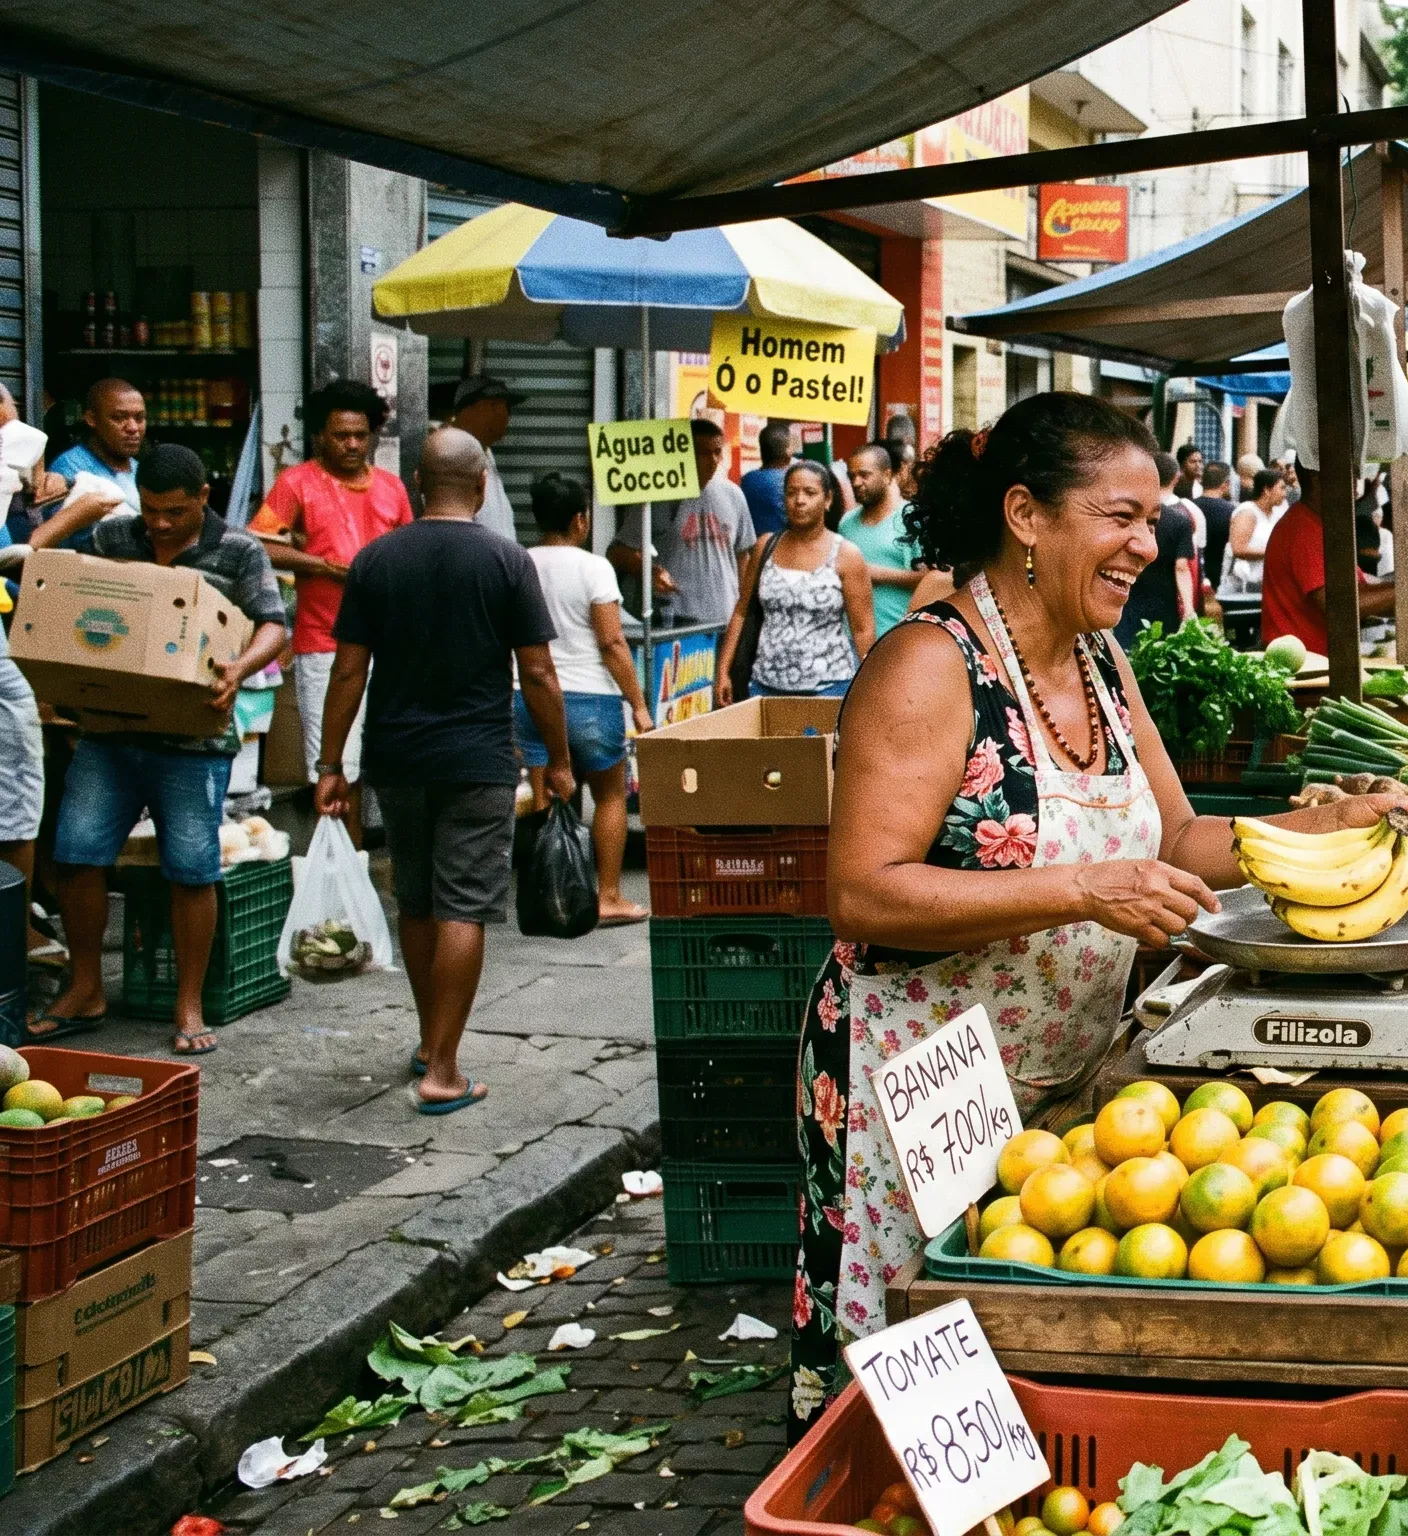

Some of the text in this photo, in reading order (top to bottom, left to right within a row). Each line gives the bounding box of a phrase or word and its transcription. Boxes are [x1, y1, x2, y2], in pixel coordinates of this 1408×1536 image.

[741, 327, 845, 364] Homem
[716, 355, 864, 403] Ó o Pastel!
[596, 425, 689, 465] Água de
[606, 461, 687, 493] Cocco!
[1266, 1021, 1358, 1045] Filizola
[883, 1024, 987, 1122] BANANA
[906, 1083, 1014, 1193] R$ 7,00/kg
[861, 1318, 979, 1401] TOMATE
[903, 1388, 1036, 1491] R$ 8,50/kg
